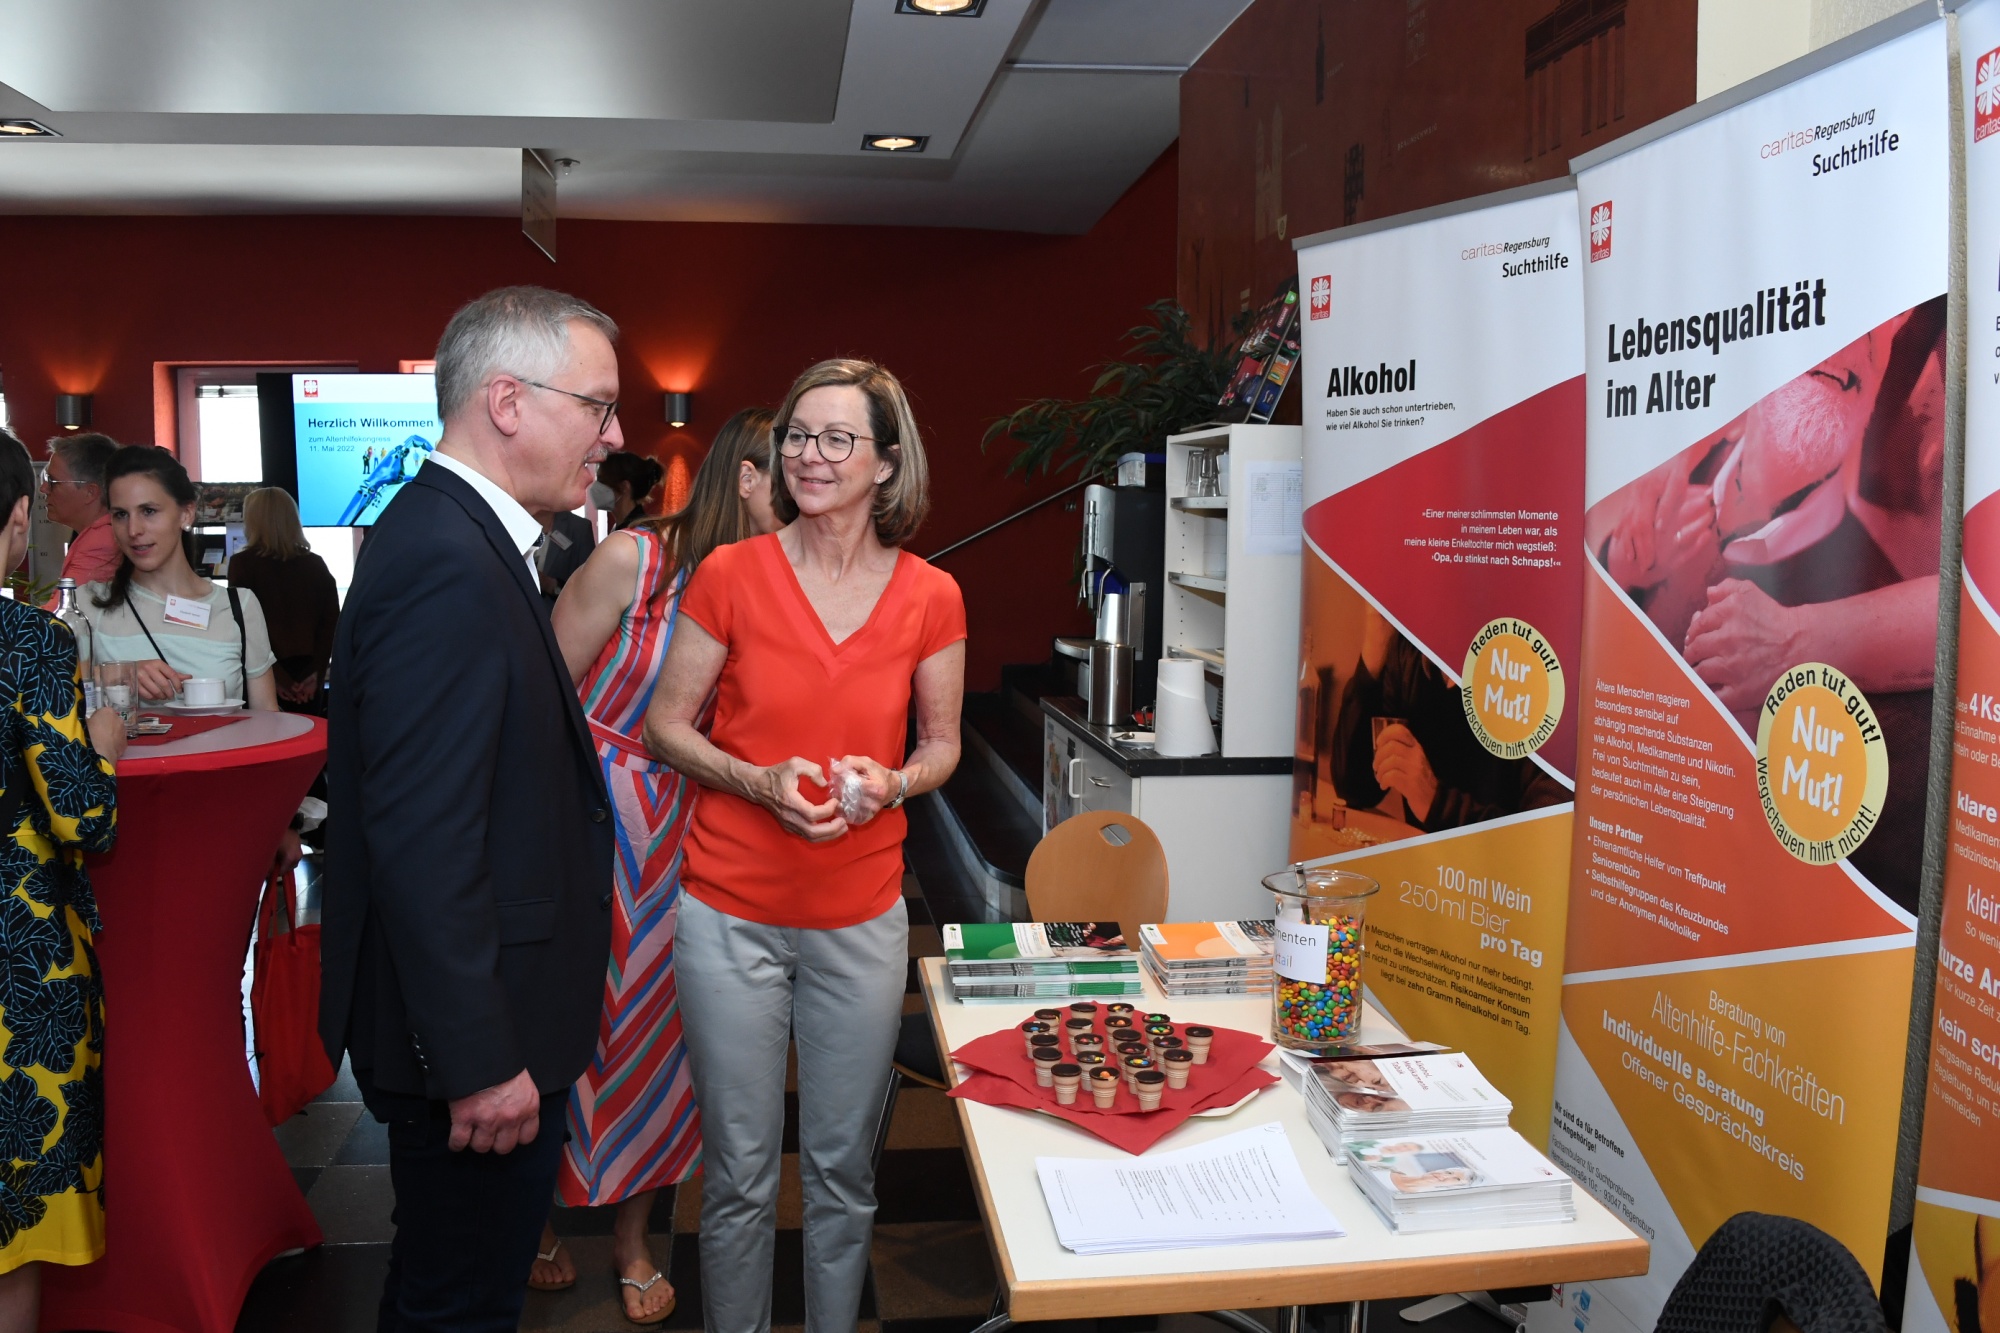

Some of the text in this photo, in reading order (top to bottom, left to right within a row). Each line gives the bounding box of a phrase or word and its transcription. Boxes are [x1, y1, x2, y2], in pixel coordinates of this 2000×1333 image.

[1812, 130, 1899, 176] Suchthilfe
[1502, 252, 1569, 278] Suchthilfe
[1608, 278, 1826, 362] Lebensqualität
[1326, 359, 1416, 398] Alkohol
[1607, 370, 1716, 418] im Alter
[308, 418, 434, 428] Herzlich Willkommen
[1325, 416, 1425, 431] wie viel Alkohol Sie trinken?
[1326, 401, 1455, 418] Haben Sie auch schon untertrieben,
[325, 436, 391, 444] Altenhilfekongress
[1469, 525, 1558, 537] meinem Leben war, als
[1471, 510, 1558, 520] schlimmsten Momente
[1404, 537, 1557, 553] meine kleine Enkeltochter mich wegstieß:
[1453, 553, 1509, 565] du stinkst nach
[1470, 620, 1560, 673] Reden tut gut!
[1490, 648, 1531, 683] Nur
[1483, 683, 1531, 725] Mut!
[1595, 678, 1690, 708] Ältere Menschen reagieren
[1595, 697, 1665, 722] besonders sensibel
[1766, 668, 1881, 744] Reden tut gut!
[1462, 685, 1557, 757] Wegschauen hilft nicht!
[1594, 715, 1713, 752] abhängig machende Substanzen
[1792, 705, 1844, 757] Nur
[1961, 721, 1996, 754] Einnahme
[1592, 749, 1701, 789] Frei von Suchtmitteln sein,
[1606, 735, 1736, 778] Alkohol, Medikamente und Nikotin.
[1970, 749, 1989, 764] oder
[1591, 784, 1707, 829] der persönlichen Lebensqualität.
[1592, 766, 1734, 820] bedeutet auch im Alter eine Steigerung
[1781, 755, 1843, 817] Mut!
[1957, 790, 1998, 823] klare
[1589, 816, 1644, 844] Unsere Partner
[1757, 757, 1876, 862] Wegschauen hilft nicht!
[1592, 852, 1640, 879] Seniorenbüro
[1593, 835, 1727, 894] Ehrenamtliche Helfer vom Treffpunkt
[1400, 881, 1510, 934] 250 ml Bier
[1436, 865, 1532, 914] 100 ml Wein
[1591, 869, 1729, 935] Selbsthilfegruppen des Kreuzbundes
[1590, 888, 1701, 942] und der Anonymen Alkoholiker
[1371, 925, 1534, 991] Menschen vertragen Alkohol mehr bedingt.
[1480, 932, 1543, 968] pro Tag
[1372, 953, 1530, 1019] nicht unterschätzen. Risikoarmer Konsum
[1375, 940, 1531, 1005] Auch Wechselwirkung Medikamenten
[1380, 969, 1531, 1036] liegt zehn Gramm Reinalkohol Tag.
[1709, 990, 1786, 1048] Beratung von
[1954, 984, 1994, 1019] kurze Zeit
[1938, 1008, 1966, 1047] kein
[1602, 1009, 1765, 1127] Individuelle Beratung
[1651, 990, 1846, 1125] Altenhilfe-Fachkräften
[1936, 1038, 1972, 1075] Langsame
[1935, 1060, 1990, 1111] Begleitung, um
[1941, 1088, 1981, 1127] vermeiden
[1563, 1109, 1624, 1158] sind Betroffene
[1563, 1122, 1597, 1154] Angehörige!
[1621, 1052, 1805, 1181] Offener Gesprächskreis
[1552, 1134, 1635, 1205] Fachambulanz Suchtprobleme
[1603, 1189, 1655, 1240] 93047 Regensburg
